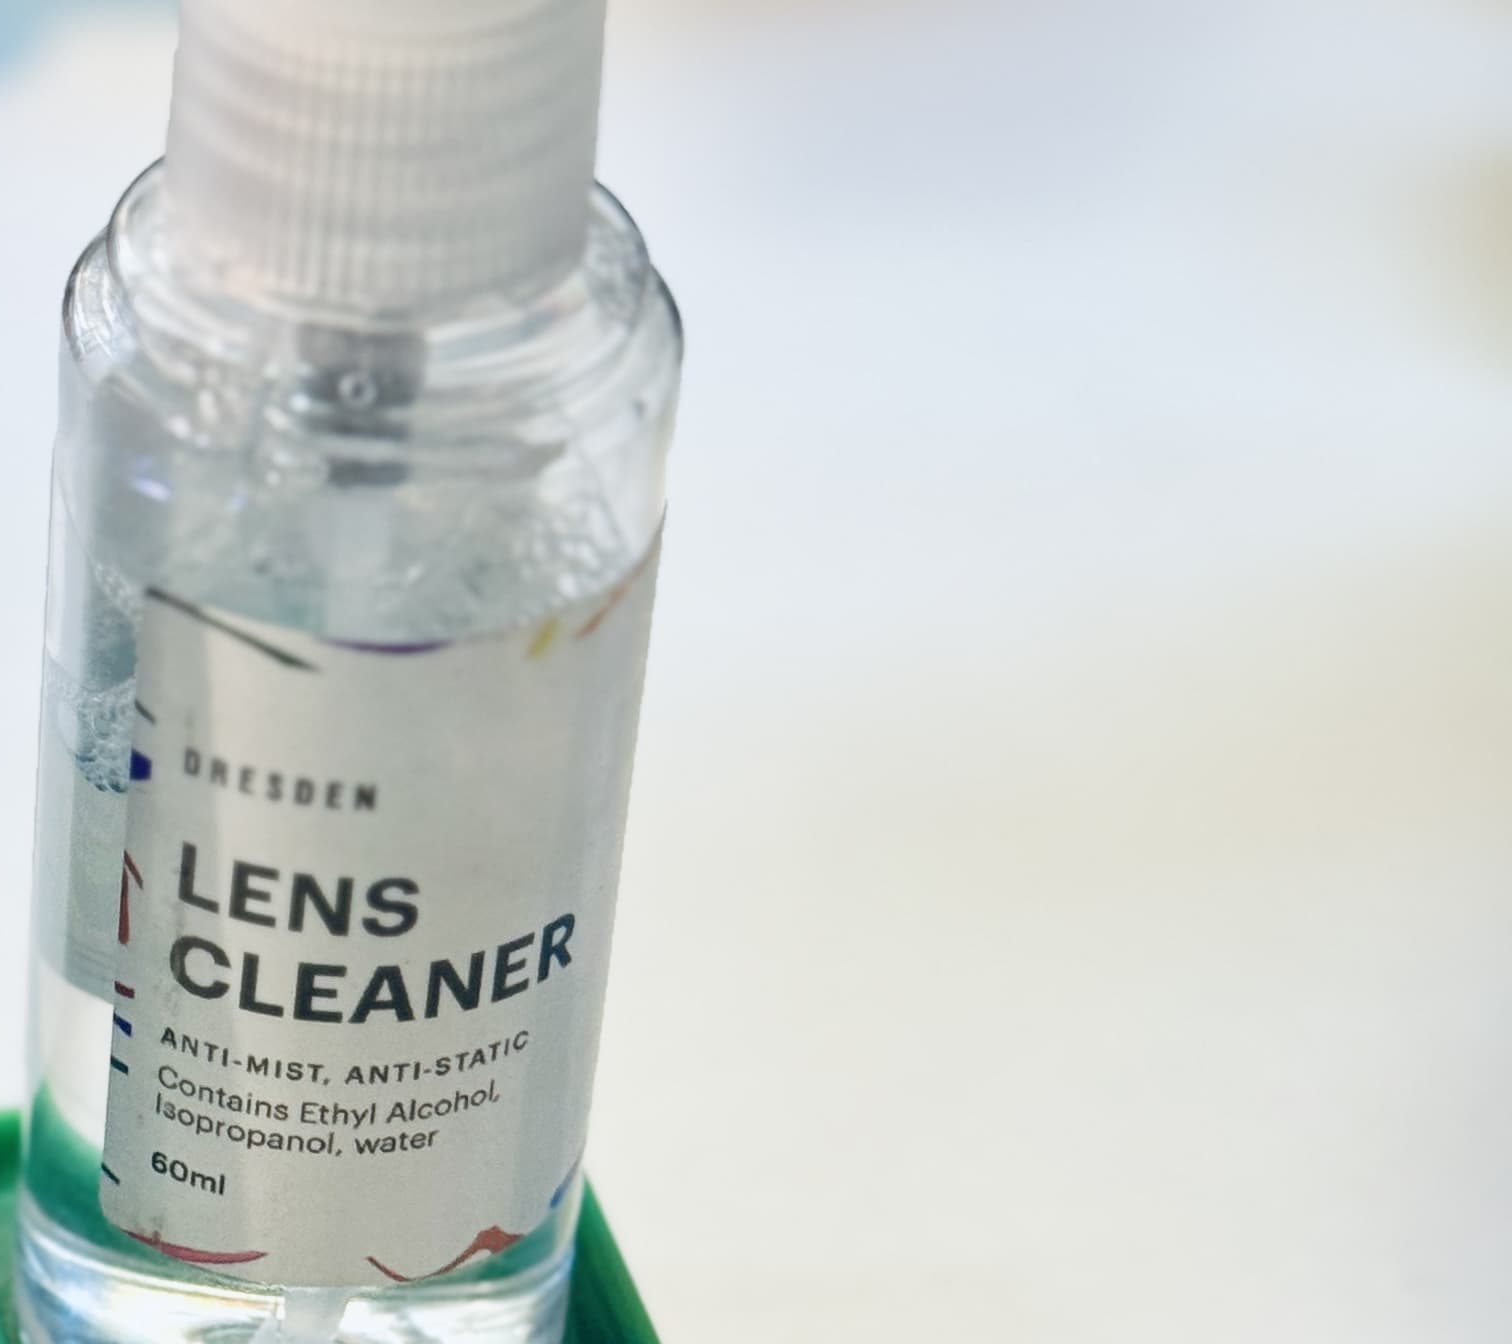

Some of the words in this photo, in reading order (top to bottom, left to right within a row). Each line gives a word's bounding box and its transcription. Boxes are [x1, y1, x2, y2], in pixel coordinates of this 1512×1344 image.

[184, 746, 376, 809] DRESDEN
[178, 840, 420, 937] LENS
[169, 913, 576, 1023] CLEANER
[160, 1026, 329, 1086] ANTI-MIST,
[344, 1030, 529, 1086] ANTI-STATIC
[155, 1093, 343, 1157] Isopropanol,
[354, 1128, 439, 1154] water
[158, 1065, 288, 1121] Contains
[300, 1101, 375, 1130] Ethyl
[386, 1080, 500, 1124] Alcohol,
[151, 1151, 226, 1196] 60ml
